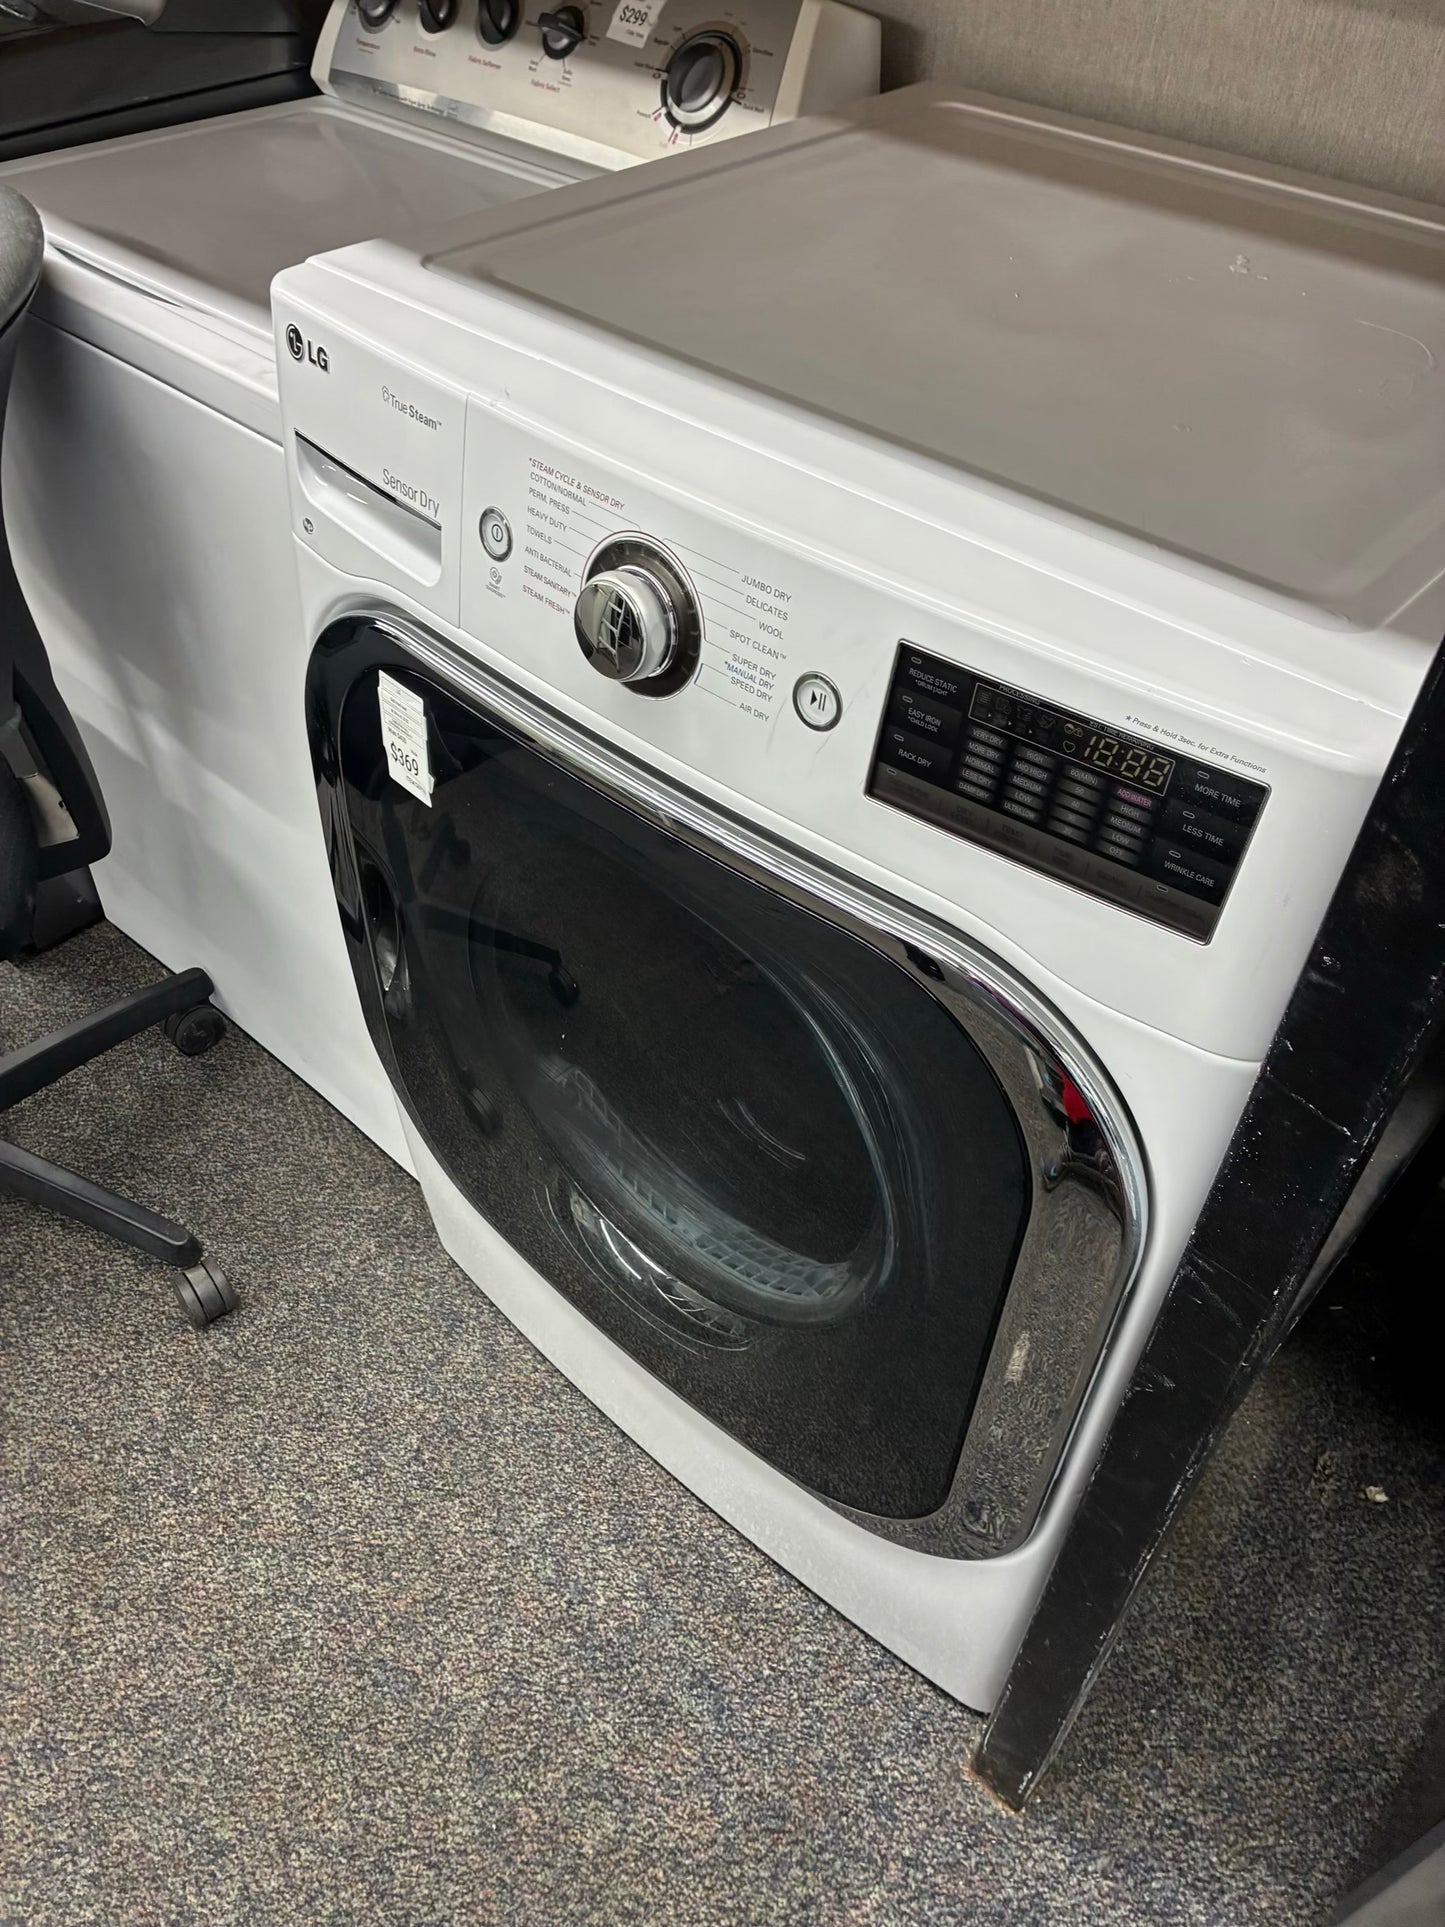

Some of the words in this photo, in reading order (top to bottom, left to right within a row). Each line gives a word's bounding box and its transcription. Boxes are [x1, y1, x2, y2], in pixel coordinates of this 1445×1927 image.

[620, 5, 648, 26] $299
[308, 340, 330, 373] LG
[382, 468, 419, 502] Sensor
[420, 490, 440, 518] Dry
[530, 472, 586, 506] COTTON/NORMAL
[555, 470, 576, 487] CYCLE
[576, 482, 582, 490] &
[583, 485, 610, 503] SENSOR
[610, 496, 625, 511] DRY
[550, 498, 570, 515] PRESS
[527, 506, 548, 523] HEAVY
[550, 517, 567, 532] DUTY
[526, 524, 552, 544] TOWELS
[524, 546, 539, 558] ANTI
[540, 554, 572, 578] BACTERIAL
[524, 565, 544, 582] STEAM
[522, 585, 544, 602] STEAM
[741, 575, 772, 595] JUMBO
[774, 588, 792, 604] DRY
[746, 594, 788, 622] DELICATES
[730, 630, 752, 646] SPOT
[758, 620, 784, 640] WOOL
[732, 653, 758, 672] SUPER
[760, 666, 777, 681] DRY
[730, 676, 754, 694] SPEED
[756, 688, 773, 703] DRY
[758, 677, 774, 691] DRY
[909, 667, 934, 684] REDUCE
[934, 678, 958, 694] STATIC
[738, 702, 752, 714] AIR
[754, 708, 770, 723] DRY
[908, 707, 925, 720] EASY
[925, 715, 942, 727] IRON
[924, 722, 938, 733] LOCK
[973, 728, 989, 740] VERY
[989, 735, 1004, 746] DRY
[968, 742, 986, 754] MORE
[986, 748, 1000, 760] DRY
[1132, 717, 1151, 732] Press
[1152, 725, 1160, 733] &
[1160, 728, 1178, 740] Hold
[1178, 736, 1196, 748] 3sec.
[1198, 742, 1209, 752] for
[1210, 746, 1230, 760] Extra
[1230, 755, 1267, 774] Functions
[390, 741, 419, 776] $369
[898, 748, 917, 762] RACK
[918, 756, 932, 768] DRY
[965, 755, 995, 774] NORMAL
[1026, 750, 1044, 764] HIGH
[979, 774, 992, 786] DRY
[1030, 766, 1048, 780] HIGH
[1070, 768, 1098, 786] 60(MIN)
[1012, 775, 1042, 793] MEDIUM
[1014, 791, 1032, 802] LOW
[1194, 783, 1220, 800] MORE
[1221, 794, 1242, 808] TIME
[1120, 805, 1140, 818] HIGH
[1110, 816, 1142, 834] MEDIUM
[1112, 833, 1130, 845] LOW
[1182, 824, 1204, 838] LESS
[1205, 832, 1225, 847] TIME
[1164, 860, 1196, 882] WRINKLE
[1196, 874, 1216, 888] CARE
